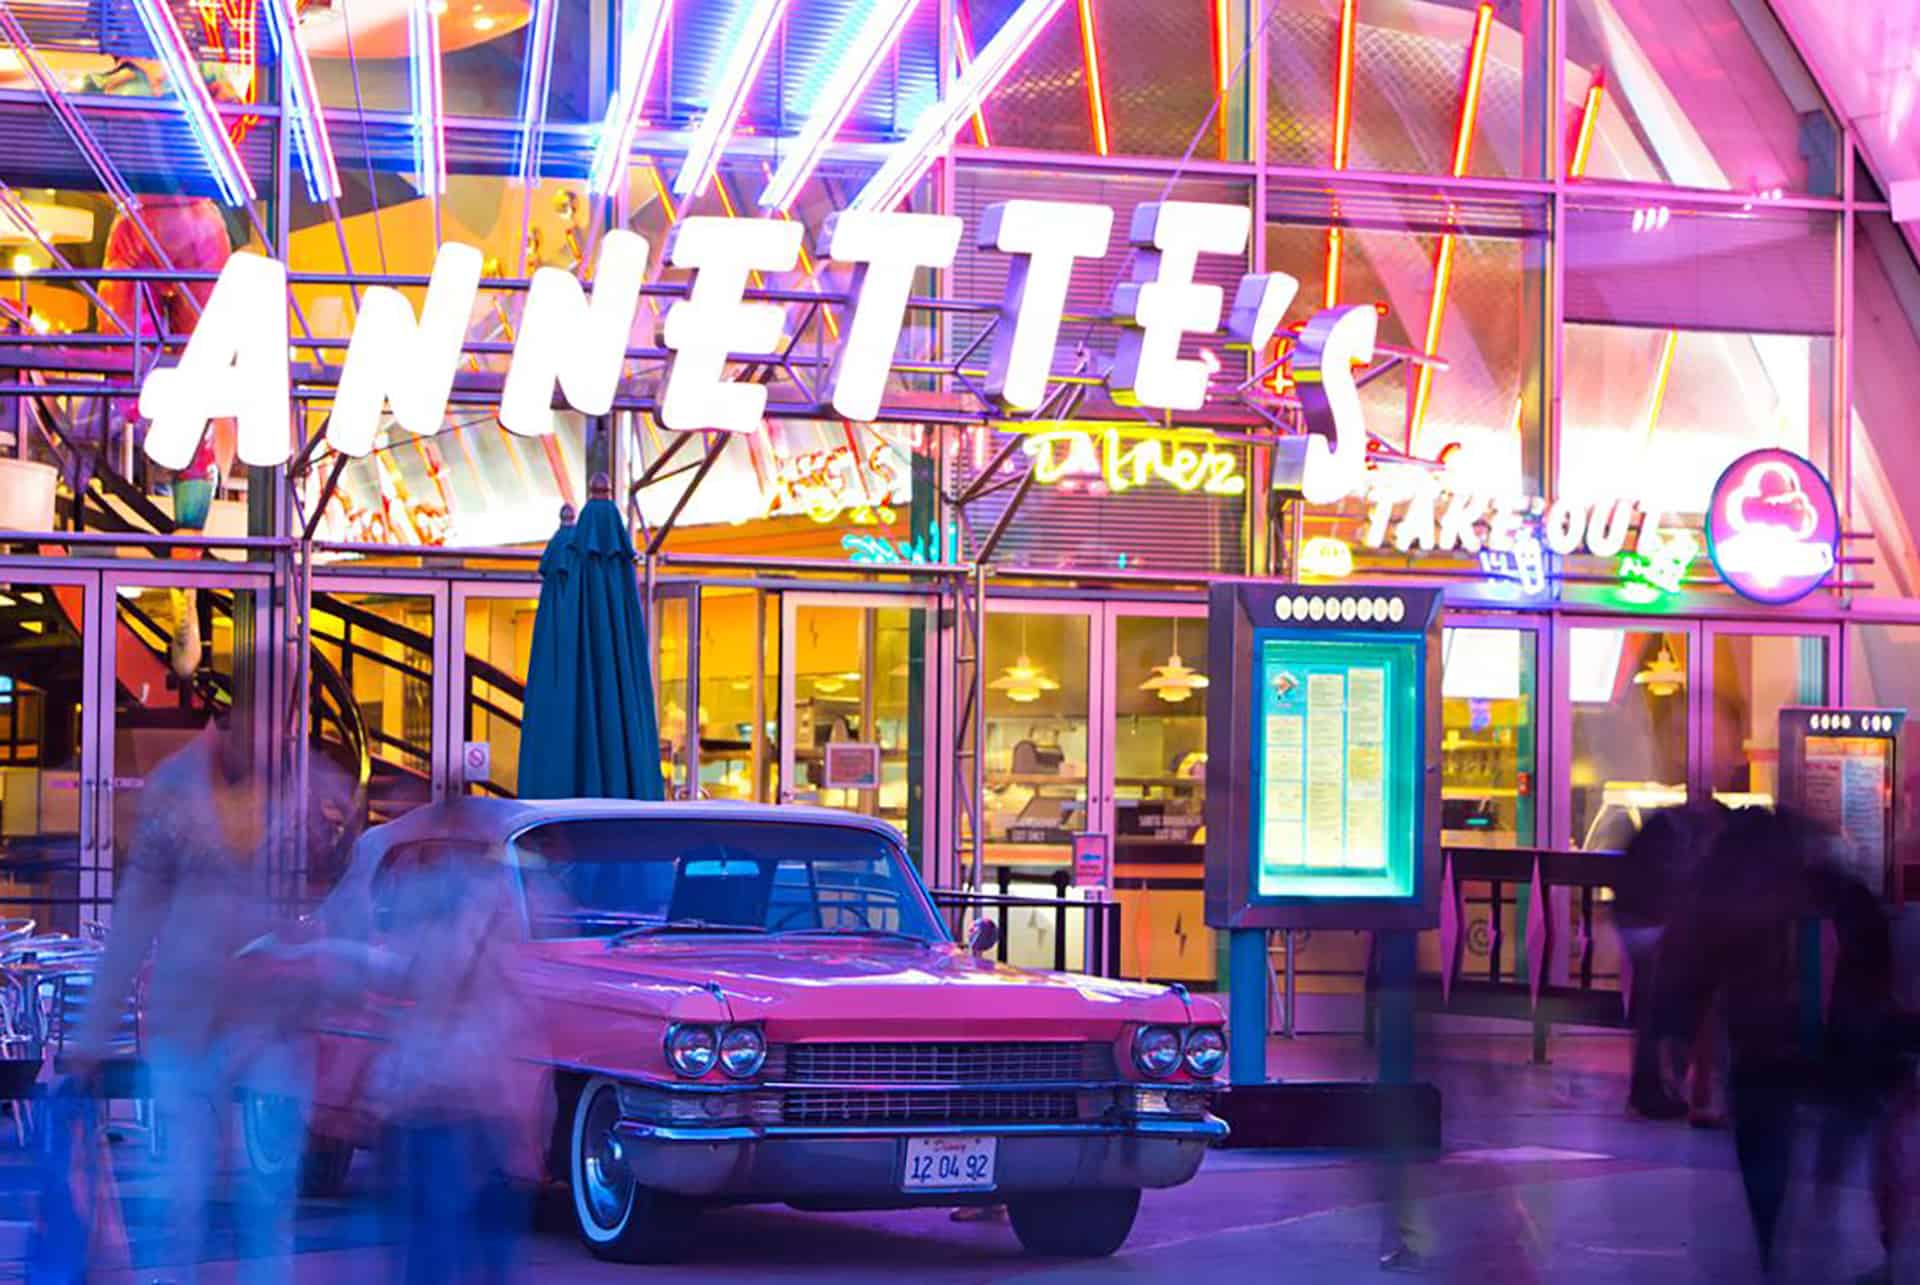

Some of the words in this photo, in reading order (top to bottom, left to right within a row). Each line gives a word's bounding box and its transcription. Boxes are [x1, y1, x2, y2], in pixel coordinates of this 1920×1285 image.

[139, 200, 1378, 504] ANNETTE'S
[1362, 482, 1538, 553] TAKE
[911, 1155, 933, 1181] 12
[939, 1155, 959, 1178] 04
[966, 1154, 988, 1180] 92
